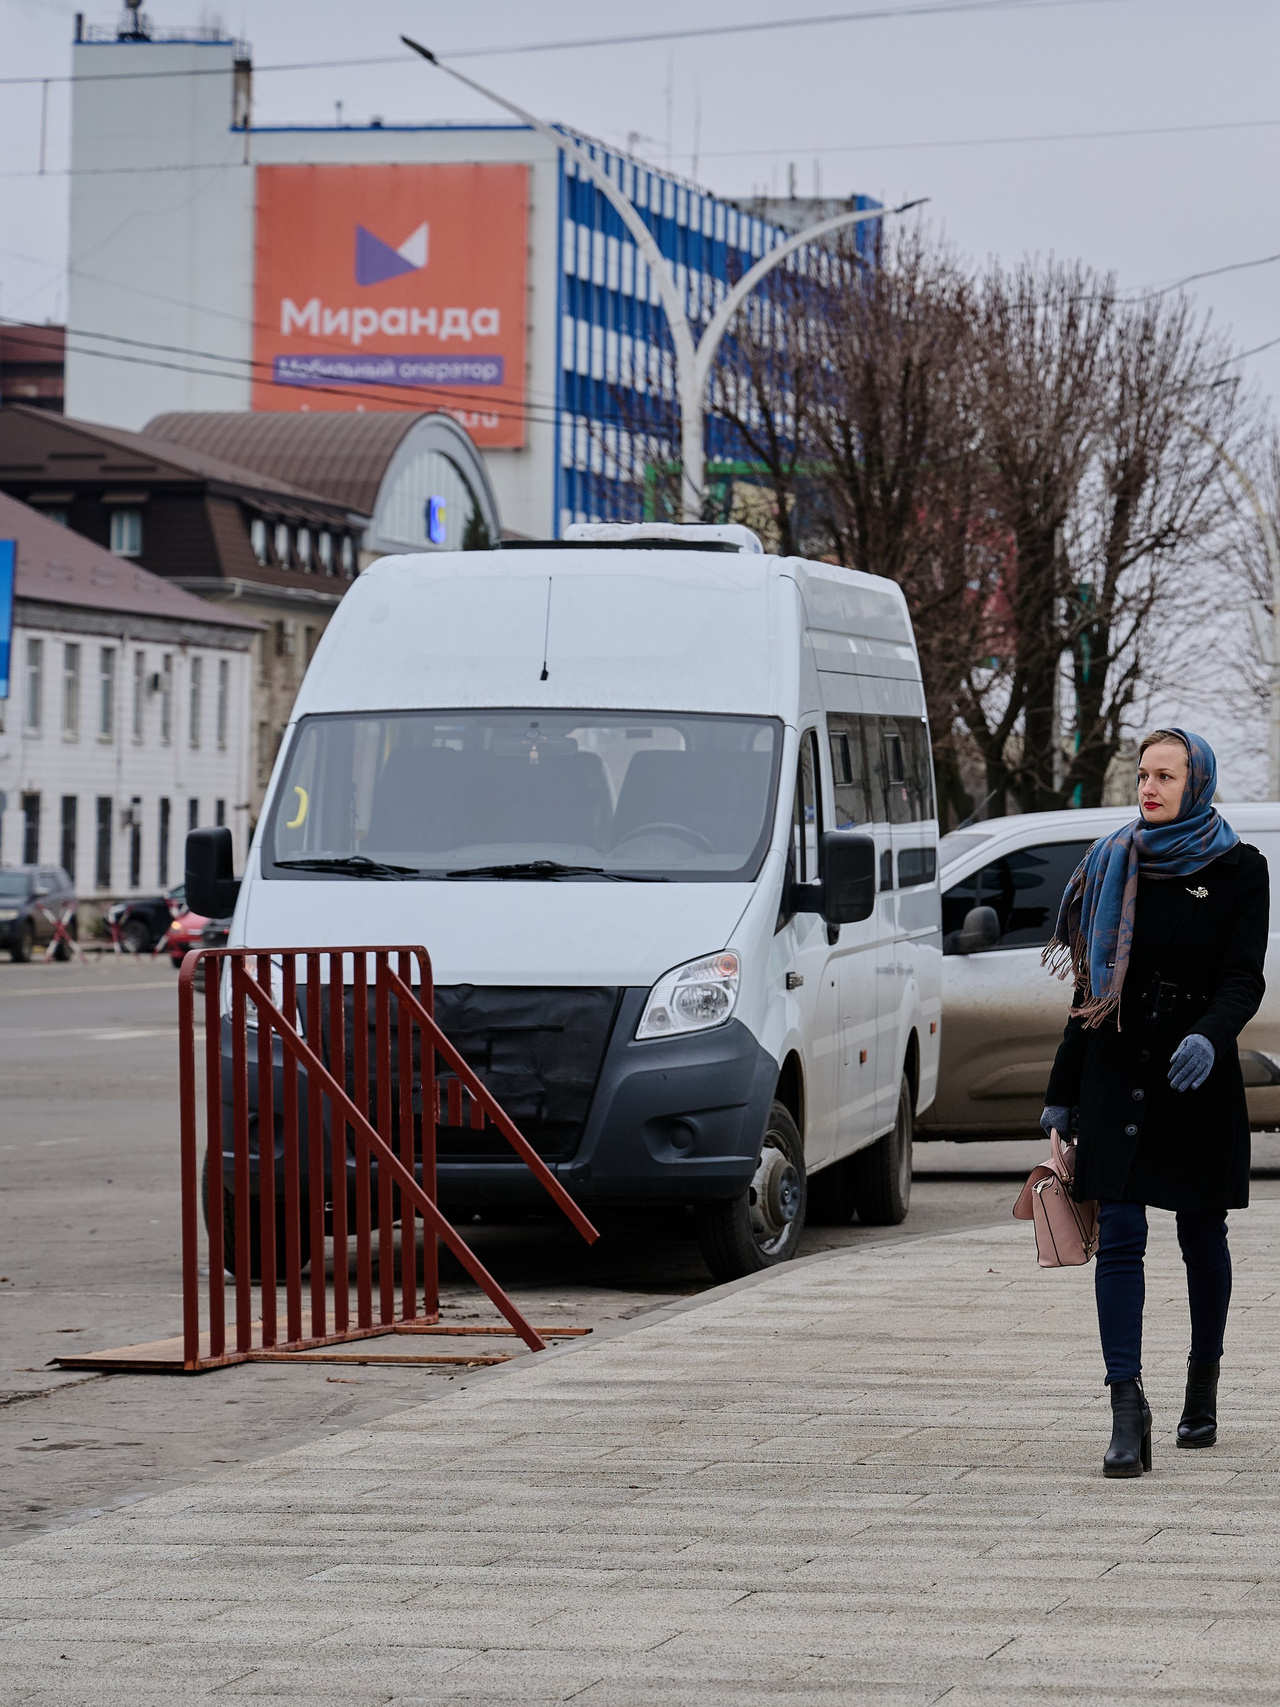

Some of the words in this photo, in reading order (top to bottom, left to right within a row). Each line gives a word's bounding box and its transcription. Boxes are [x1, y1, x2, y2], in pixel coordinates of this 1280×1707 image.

[280, 298, 499, 345] Миранда
[278, 358, 395, 379] Мобильный
[399, 362, 499, 382] оператор
